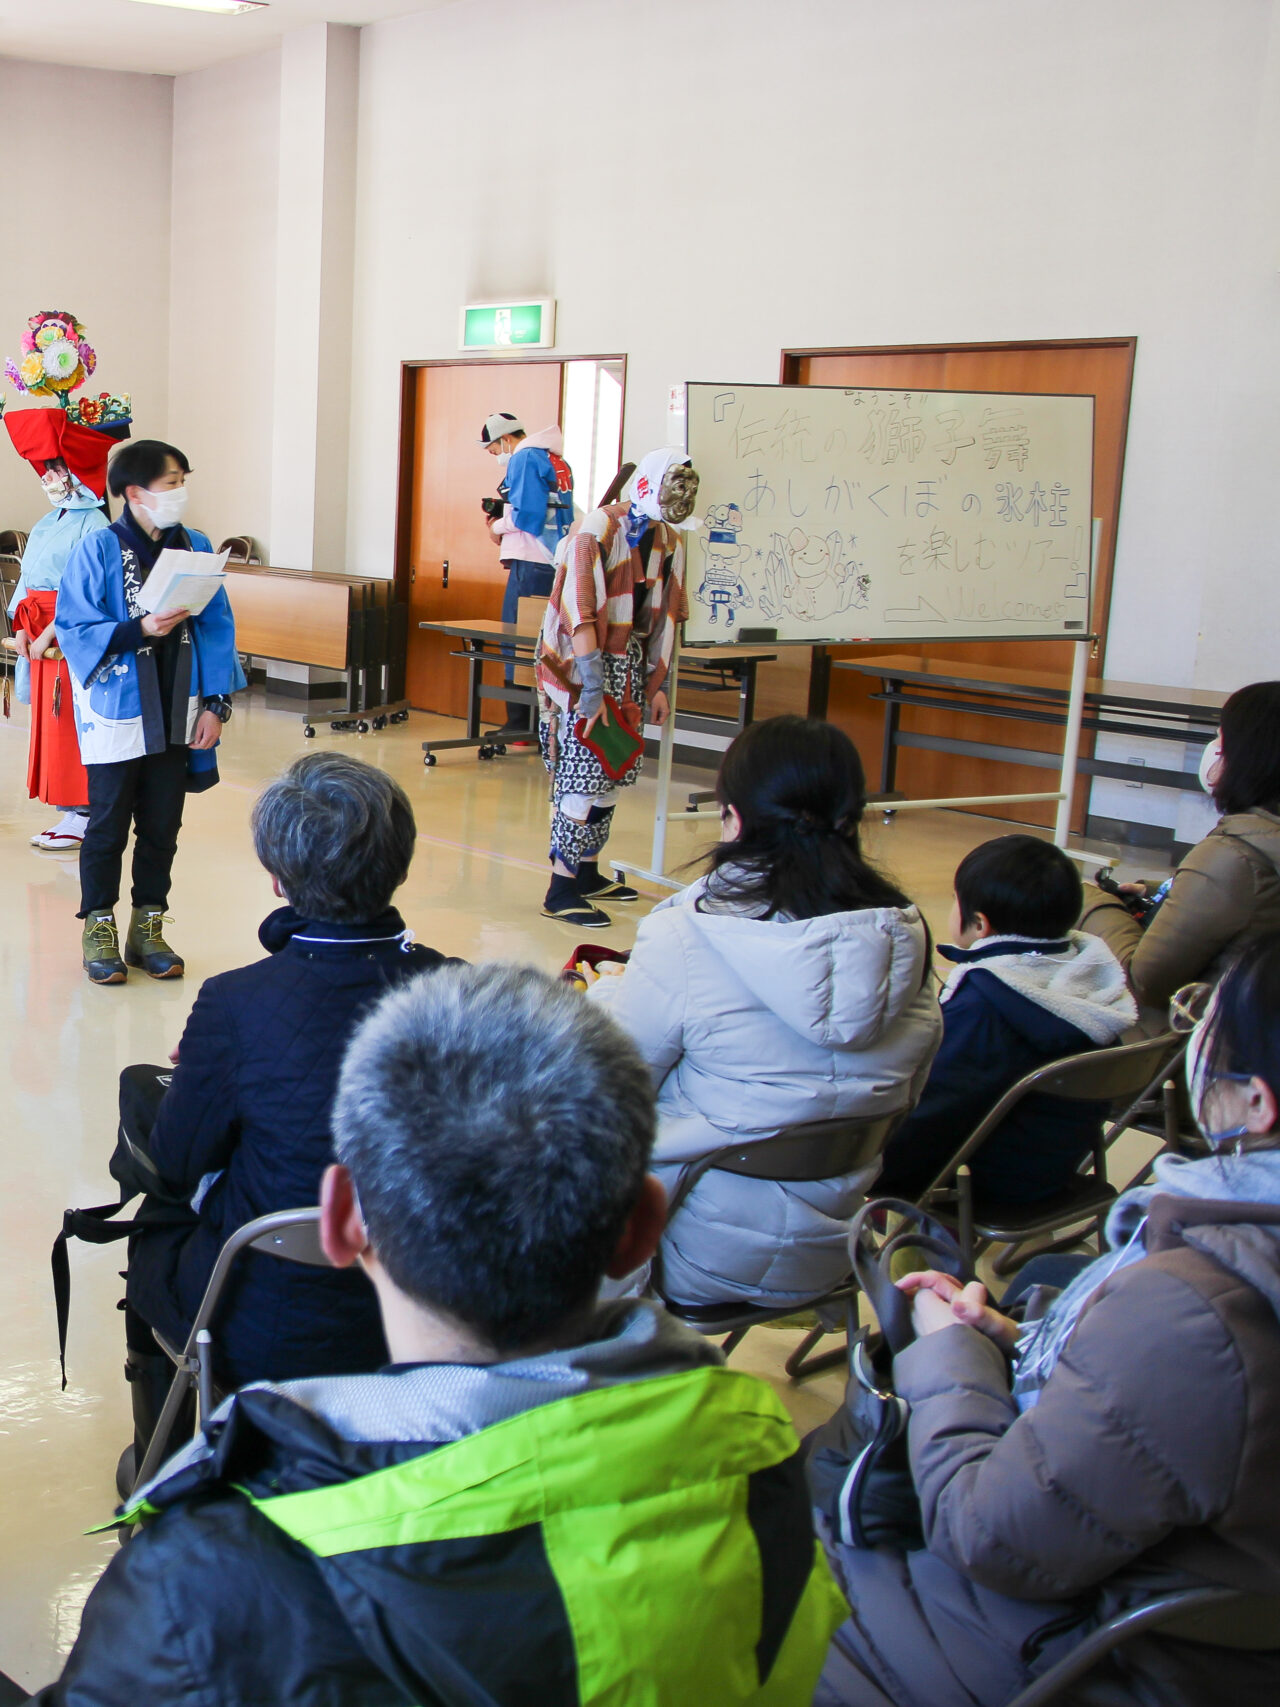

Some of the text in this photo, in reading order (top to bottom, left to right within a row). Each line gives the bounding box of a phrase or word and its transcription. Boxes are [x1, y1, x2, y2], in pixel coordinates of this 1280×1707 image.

[743, 468, 1070, 527] あしがくぼの氷柱
